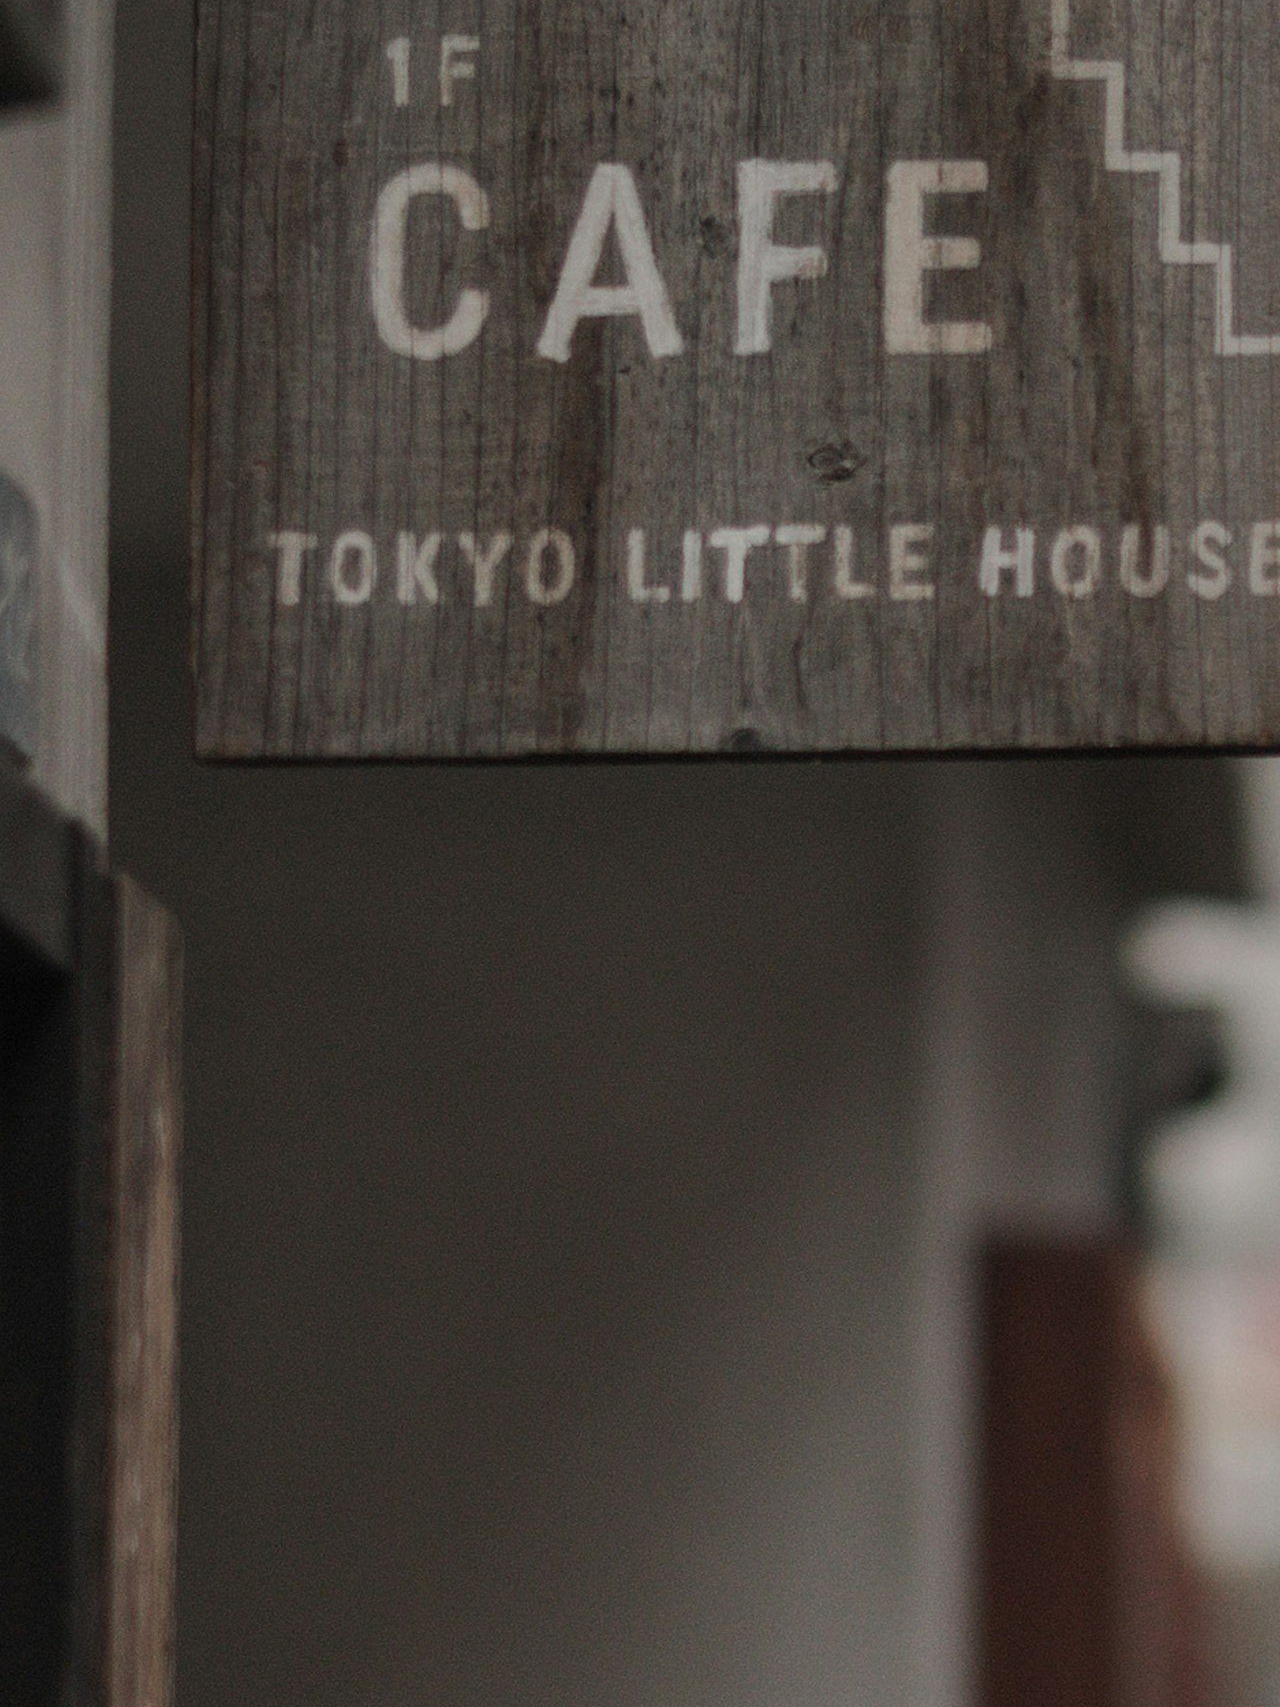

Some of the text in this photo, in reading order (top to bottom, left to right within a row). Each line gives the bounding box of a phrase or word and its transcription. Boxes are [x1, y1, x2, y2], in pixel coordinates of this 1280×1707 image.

[385, 35, 482, 108] 1F
[370, 159, 994, 363] CAFE
[269, 529, 578, 610] TOKYO
[627, 522, 937, 605] LITTLE
